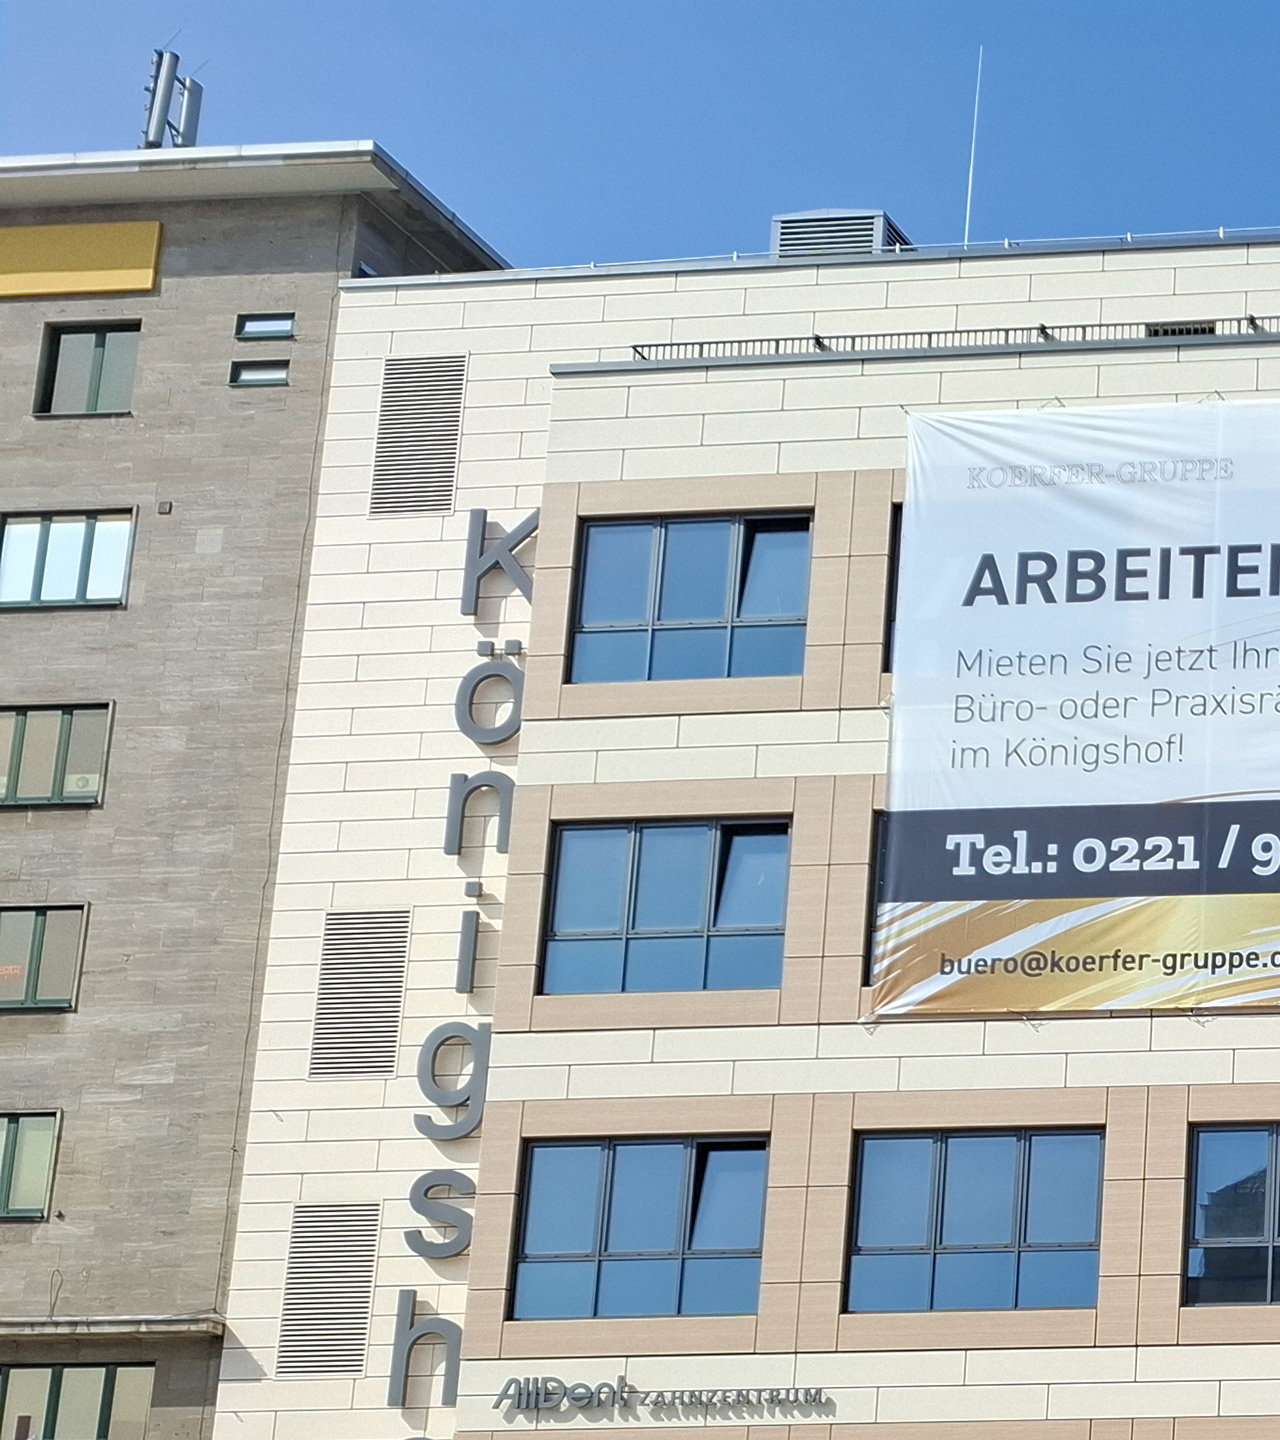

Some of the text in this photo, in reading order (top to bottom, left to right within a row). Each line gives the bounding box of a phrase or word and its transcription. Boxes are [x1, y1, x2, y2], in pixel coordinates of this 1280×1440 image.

[966, 457, 1234, 490] KOERFER-GRUPPE
[956, 648, 1068, 678] Mieten
[1081, 643, 1133, 675] Sie
[1143, 642, 1219, 680] jetzt
[953, 692, 1048, 724] Büro-
[1058, 690, 1138, 720] oder
[950, 733, 1185, 773] im Königshof!
[946, 831, 1058, 876] Tel.:
[1072, 834, 1201, 873] 0221
[1218, 824, 1241, 869] /
[491, 1374, 824, 1410] AllDent ZAHNZENTRUM
